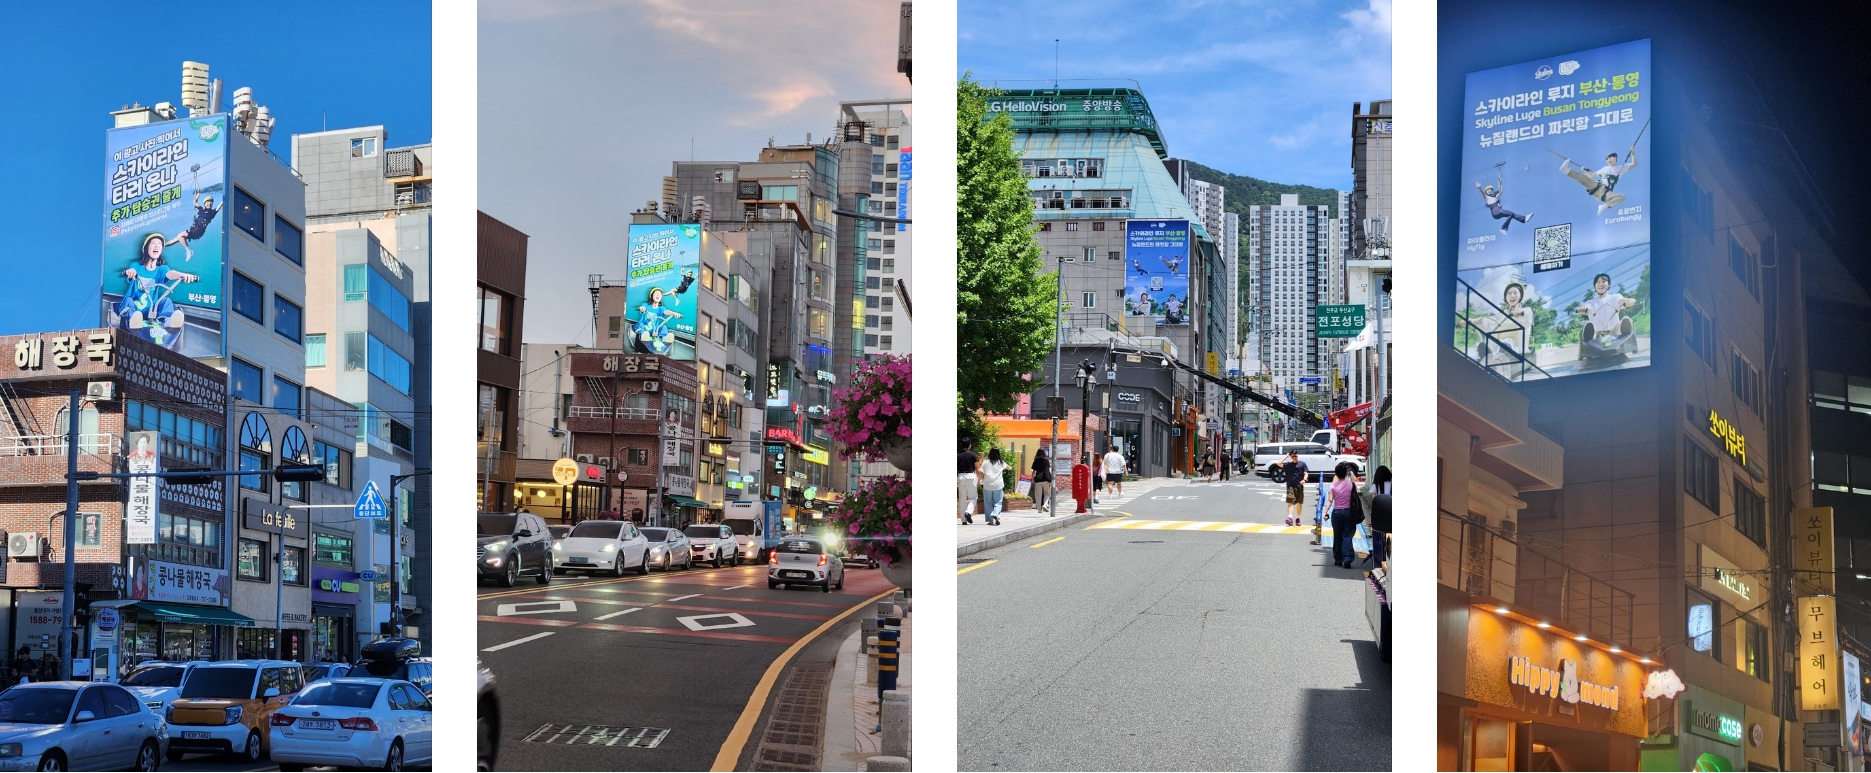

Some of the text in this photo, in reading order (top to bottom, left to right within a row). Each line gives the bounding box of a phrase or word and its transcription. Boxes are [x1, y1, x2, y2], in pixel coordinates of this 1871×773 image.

[1475, 72, 1640, 115] 스카이라인 루지 부산·통영
[1002, 101, 1067, 112] HelloVision
[1082, 100, 1123, 112] 중앙방송
[1475, 91, 1640, 129] Skyline Luge Busan Tongyeong
[1479, 108, 1634, 149] 뉴질랜드의 짜릿함 그대로
[113, 127, 181, 162] 이 광고 사진 찍어서
[112, 138, 188, 185] 스카이라인
[112, 164, 178, 205] 타러 온나
[111, 204, 131, 223] 추가
[131, 192, 160, 216] 탑승권
[1617, 206, 1641, 216] 유로번지
[1604, 213, 1642, 225] Eurobungy
[631, 235, 679, 257] 스카이라인
[1467, 234, 1496, 245] 하이플라이
[1467, 243, 1485, 252] Hyfly
[631, 255, 650, 268] 타러
[1318, 315, 1365, 328] 전포성당
[14, 333, 113, 370] 해장국
[603, 356, 660, 372] 해장국
[1118, 392, 1140, 401] CODE
[768, 429, 788, 438] BAR
[1709, 410, 1746, 466] 쏘이뷰티
[262, 508, 273, 526] La
[159, 565, 212, 591] 콩나물해장국
[332, 580, 341, 593] CU
[1808, 606, 1826, 696] 무브헤어
[1511, 656, 1561, 698] Hippy
